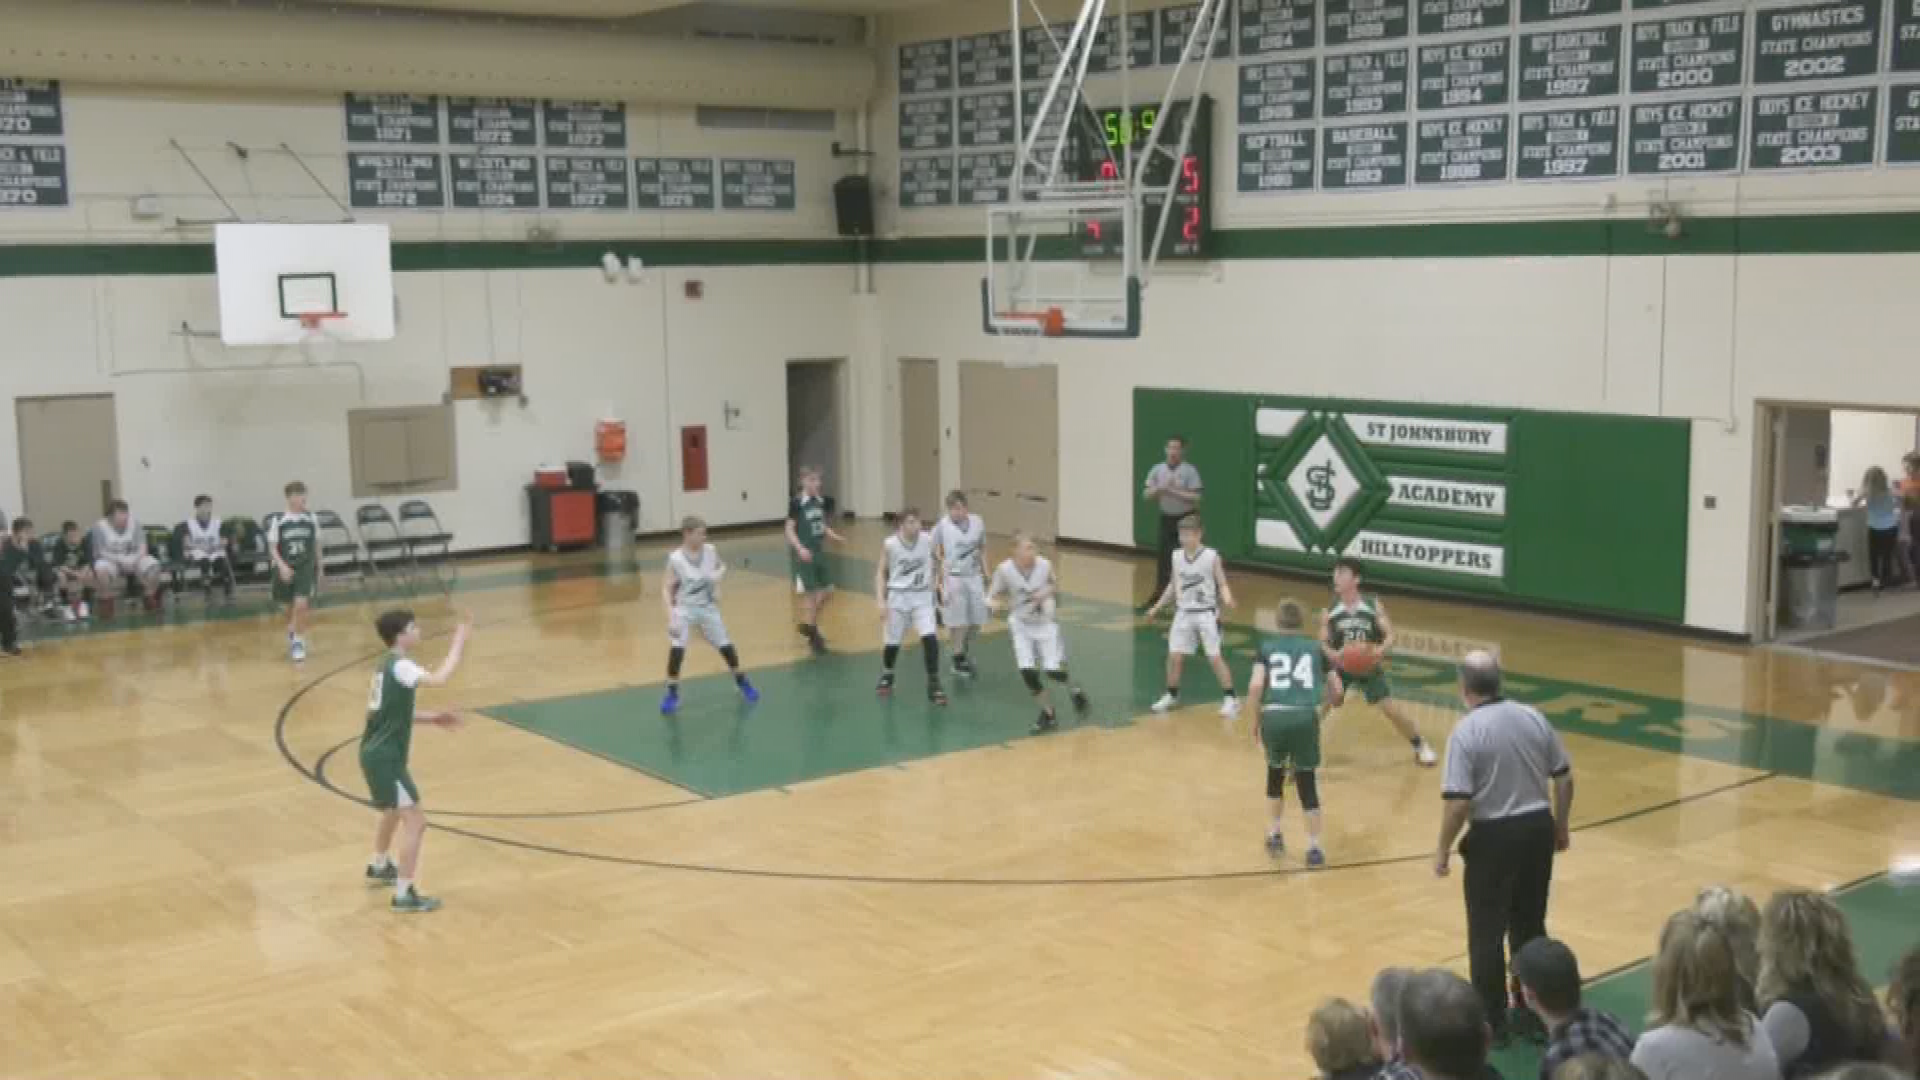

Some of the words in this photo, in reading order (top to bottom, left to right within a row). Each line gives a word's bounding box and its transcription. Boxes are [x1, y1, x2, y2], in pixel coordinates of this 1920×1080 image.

[1771, 6, 1865, 32] GYMNASTICS
[1761, 39, 1798, 55] STATE
[1801, 30, 1873, 51] CHAMPIONS
[1637, 56, 1669, 71] STATE
[1673, 49, 1736, 67] CHAMPIONS
[1784, 56, 1846, 78] 2002
[1657, 68, 1713, 88] 2000
[1689, 101, 1734, 119] HOCKEY
[1759, 98, 1791, 116] BOYS
[1795, 95, 1815, 113] ICE
[1820, 91, 1870, 110] HOCKEY
[1670, 134, 1734, 151] CHAMPIONS
[1757, 131, 1793, 147] STATE
[1797, 127, 1869, 144] CHAMPIONS
[1658, 152, 1706, 169] 2001
[1780, 145, 1842, 165] 2003
[1367, 421, 1387, 438] ST
[1390, 424, 1493, 444] JOHNSBURY
[1398, 484, 1496, 508] ACADEMY
[1360, 538, 1492, 569] HILLTOPPERS
[1268, 653, 1315, 690] 24
